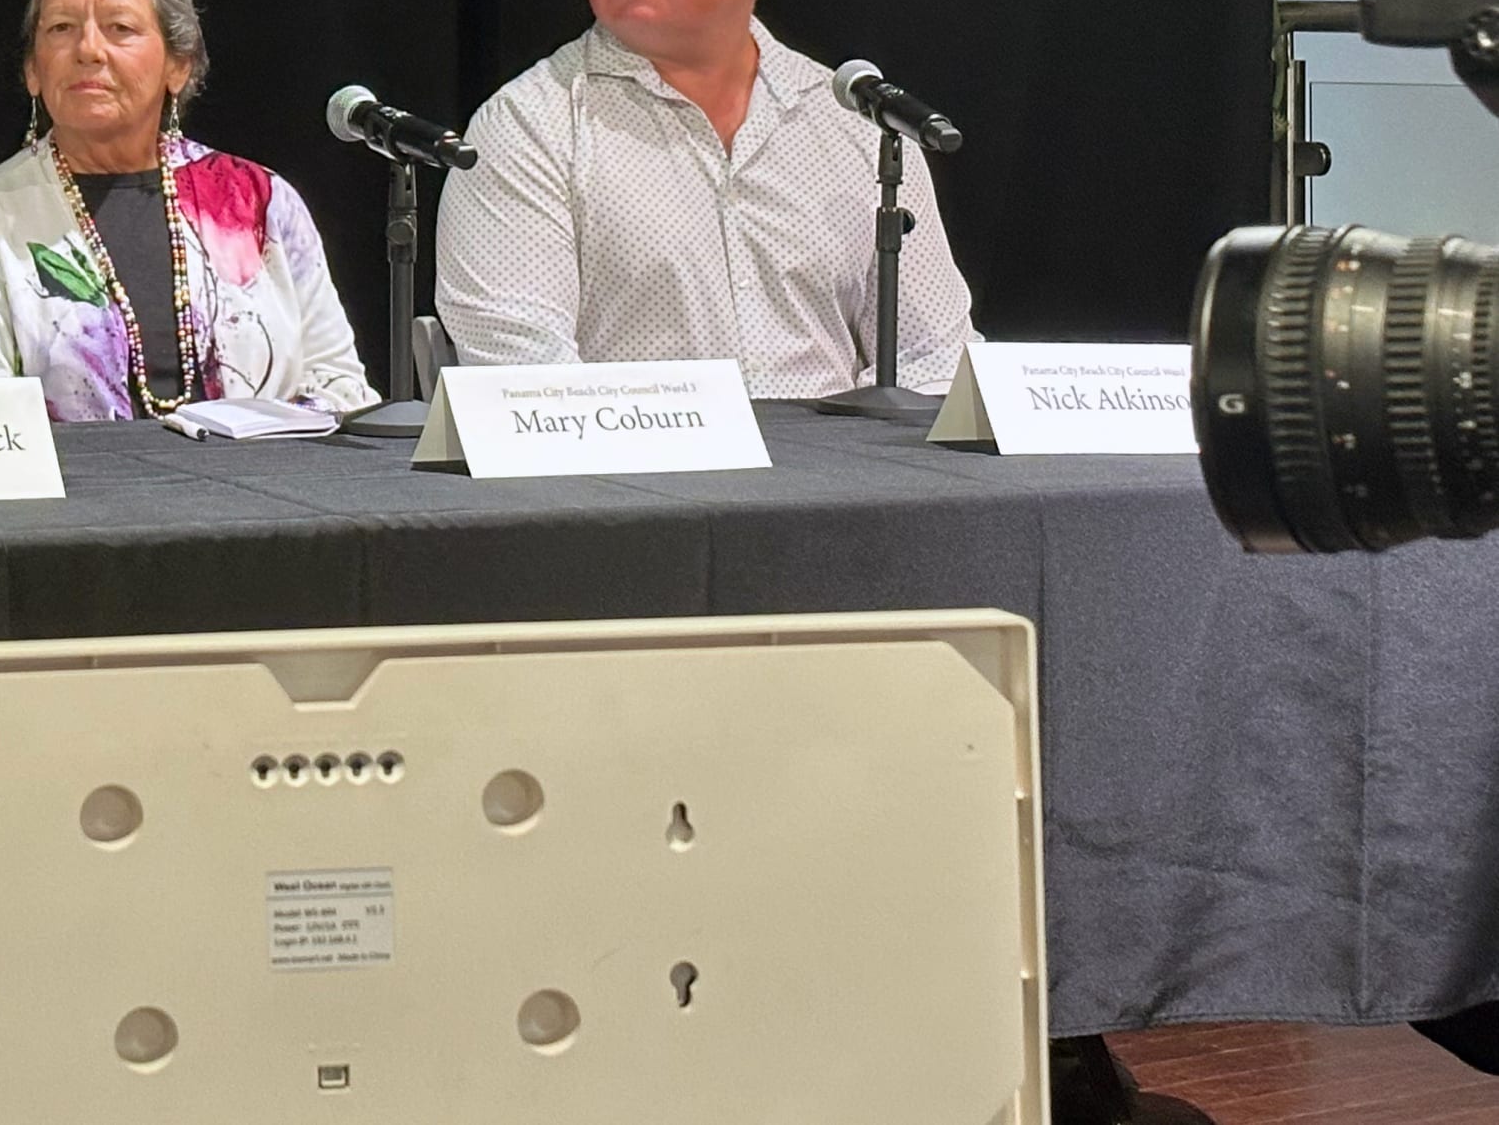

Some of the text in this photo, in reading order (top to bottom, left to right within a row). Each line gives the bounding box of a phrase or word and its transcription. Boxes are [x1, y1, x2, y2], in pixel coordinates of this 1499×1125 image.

[501, 383, 697, 399] Panama City Beach City Council Ward 3
[1027, 385, 1191, 411] Nick Atkinso
[511, 405, 705, 440] Mary Coburn
